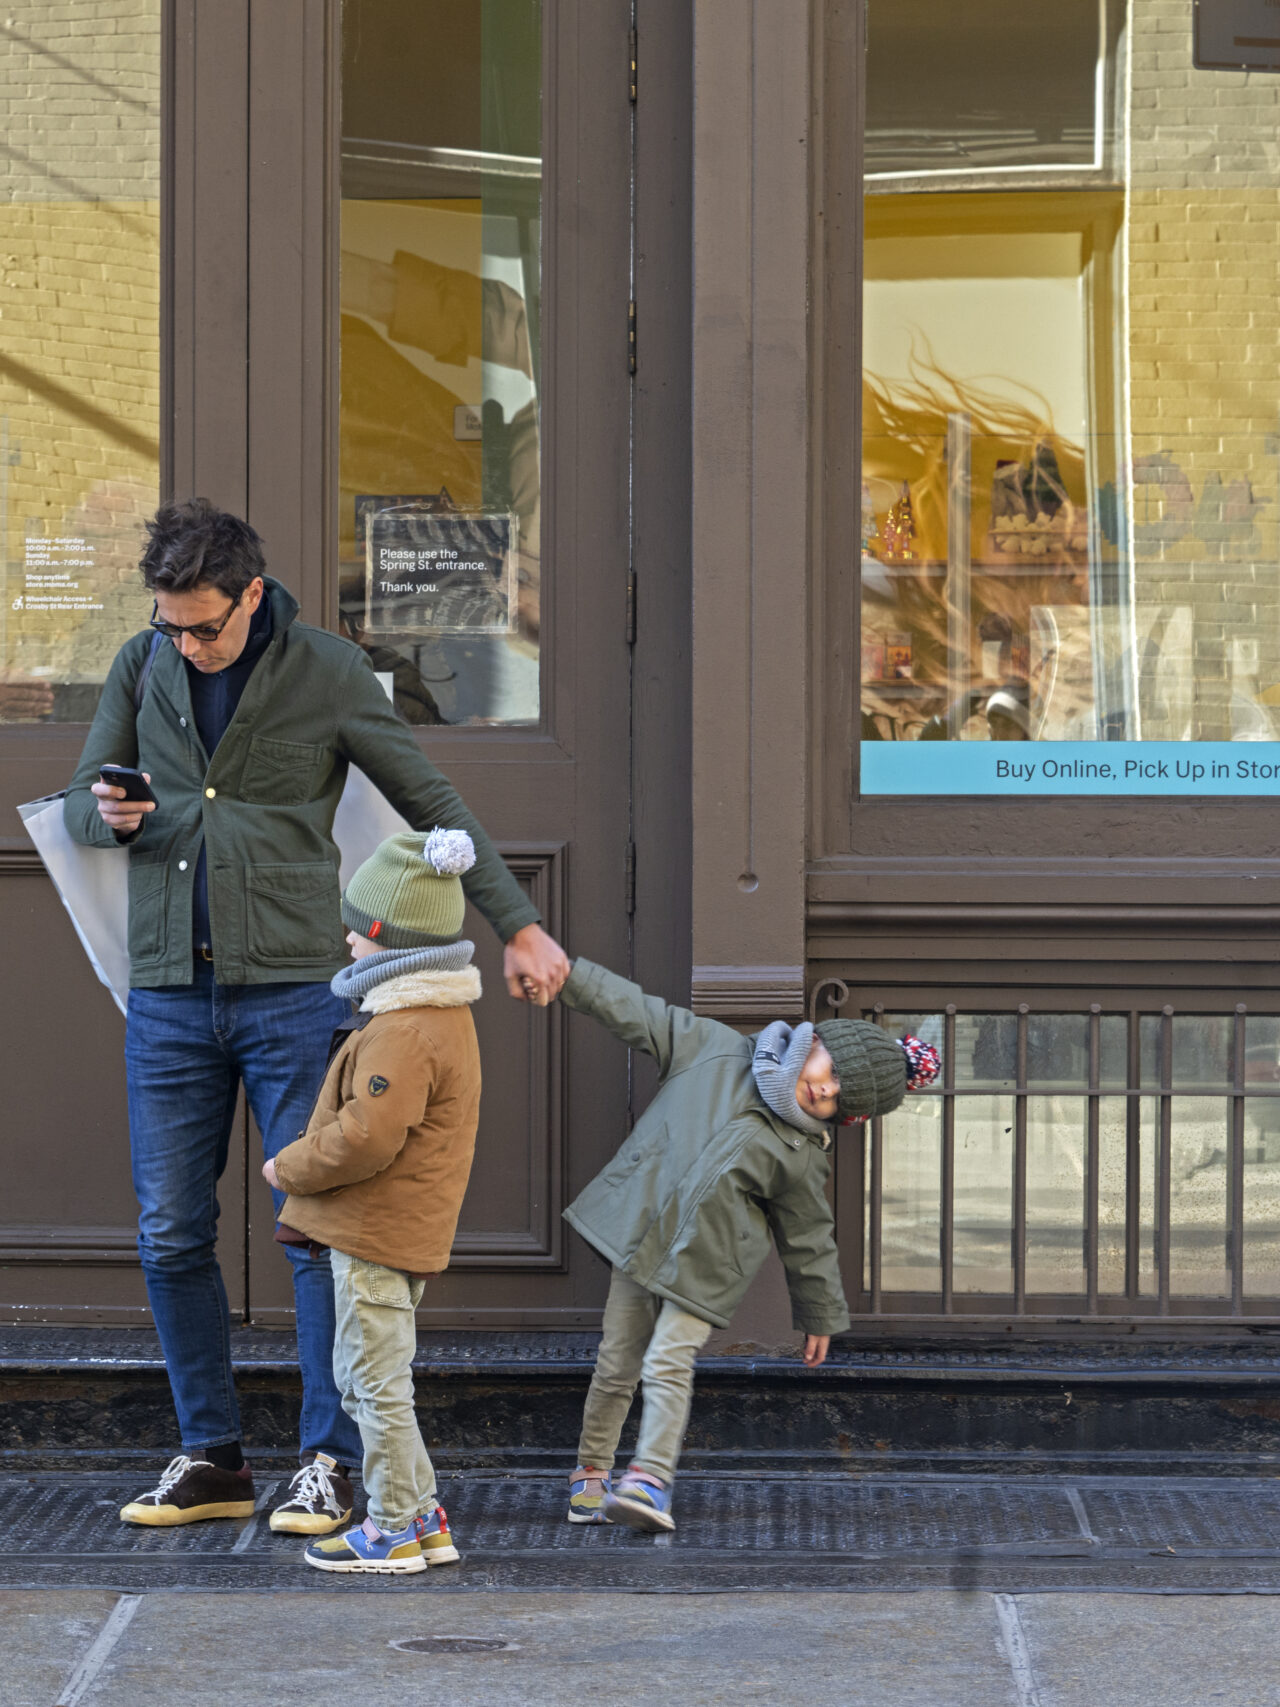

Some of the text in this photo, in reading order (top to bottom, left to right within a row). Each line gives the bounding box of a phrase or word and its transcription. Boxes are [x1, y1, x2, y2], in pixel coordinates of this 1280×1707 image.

[380, 548, 458, 560] Please use the
[380, 560, 488, 572] Spring St. entrance.
[380, 581, 440, 595] Thank you.
[25, 603, 49, 611] Crosby
[996, 759, 1036, 782] Buy
[1042, 759, 1117, 780] Online,
[1124, 759, 1169, 778] Pick
[1176, 760, 1205, 782] Up
[1211, 760, 1230, 778] in
